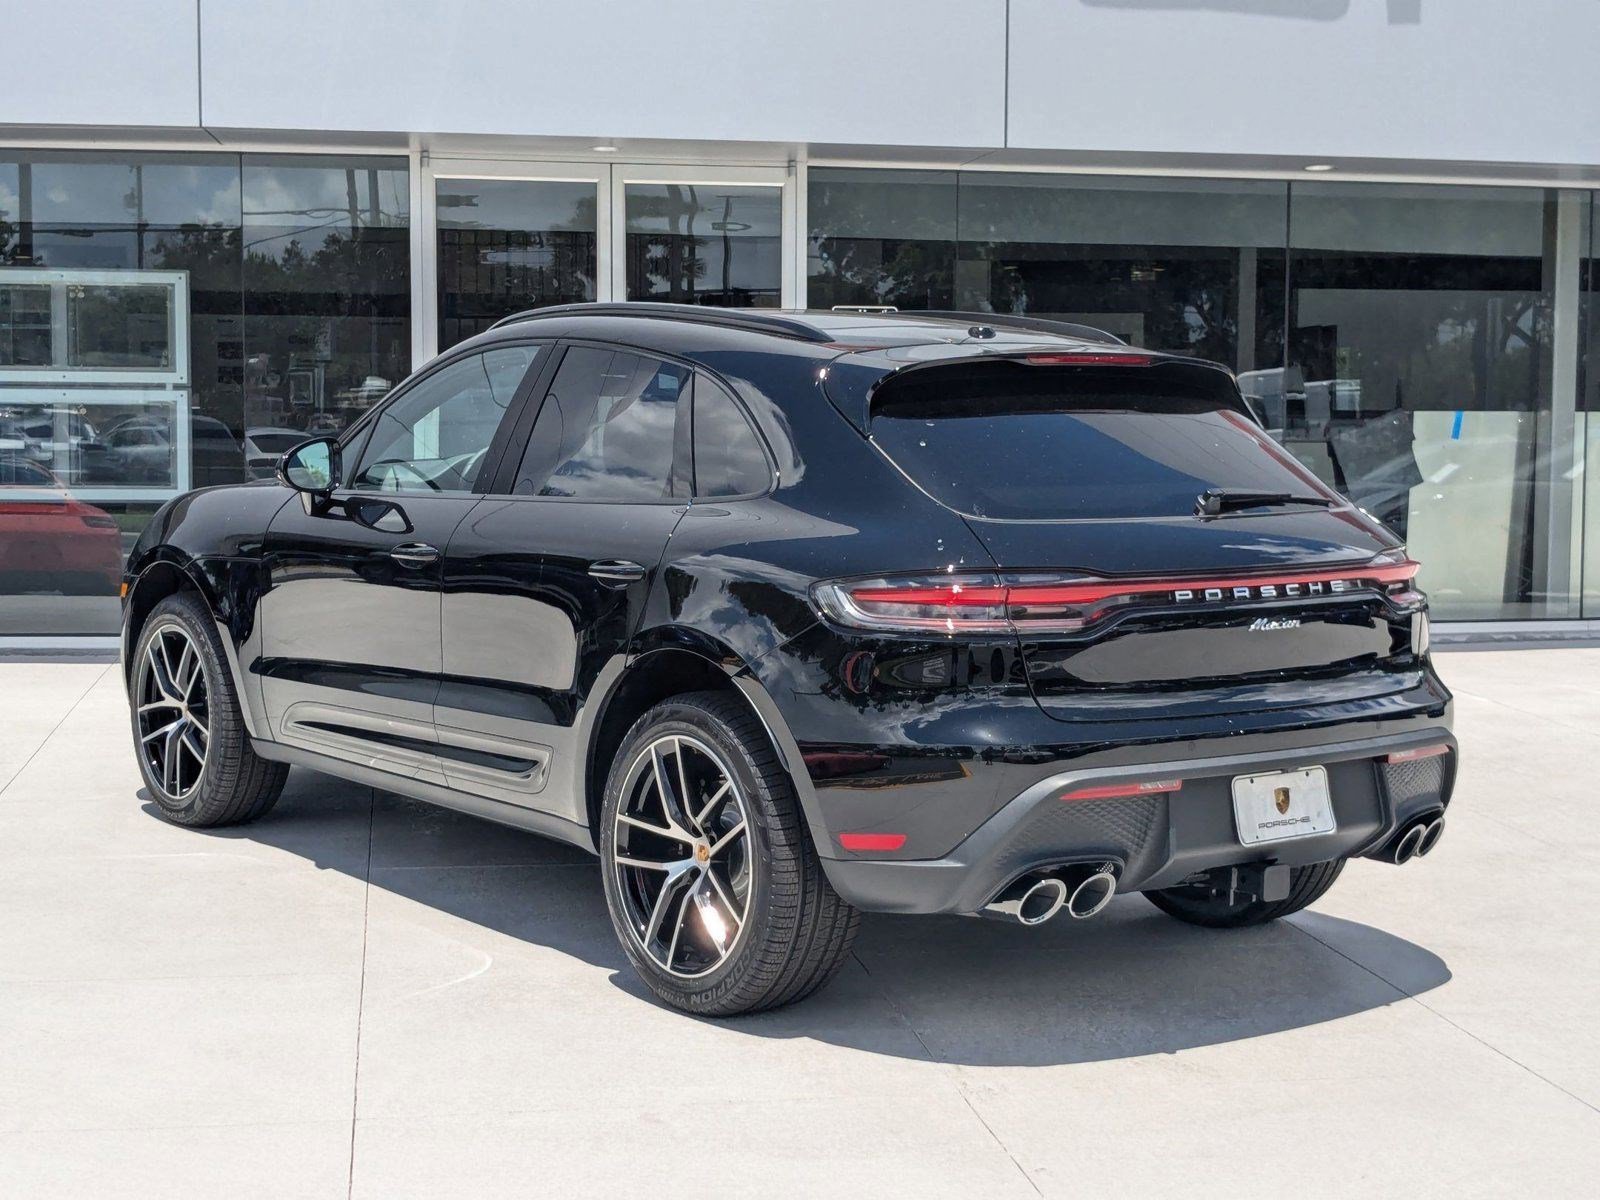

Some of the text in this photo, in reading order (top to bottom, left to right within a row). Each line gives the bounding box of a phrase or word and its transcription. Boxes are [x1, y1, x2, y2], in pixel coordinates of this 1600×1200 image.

[1175, 580, 1345, 601] PORSCHE
[1248, 617, 1301, 632] Macan
[1257, 815, 1311, 829] PORSCHE
